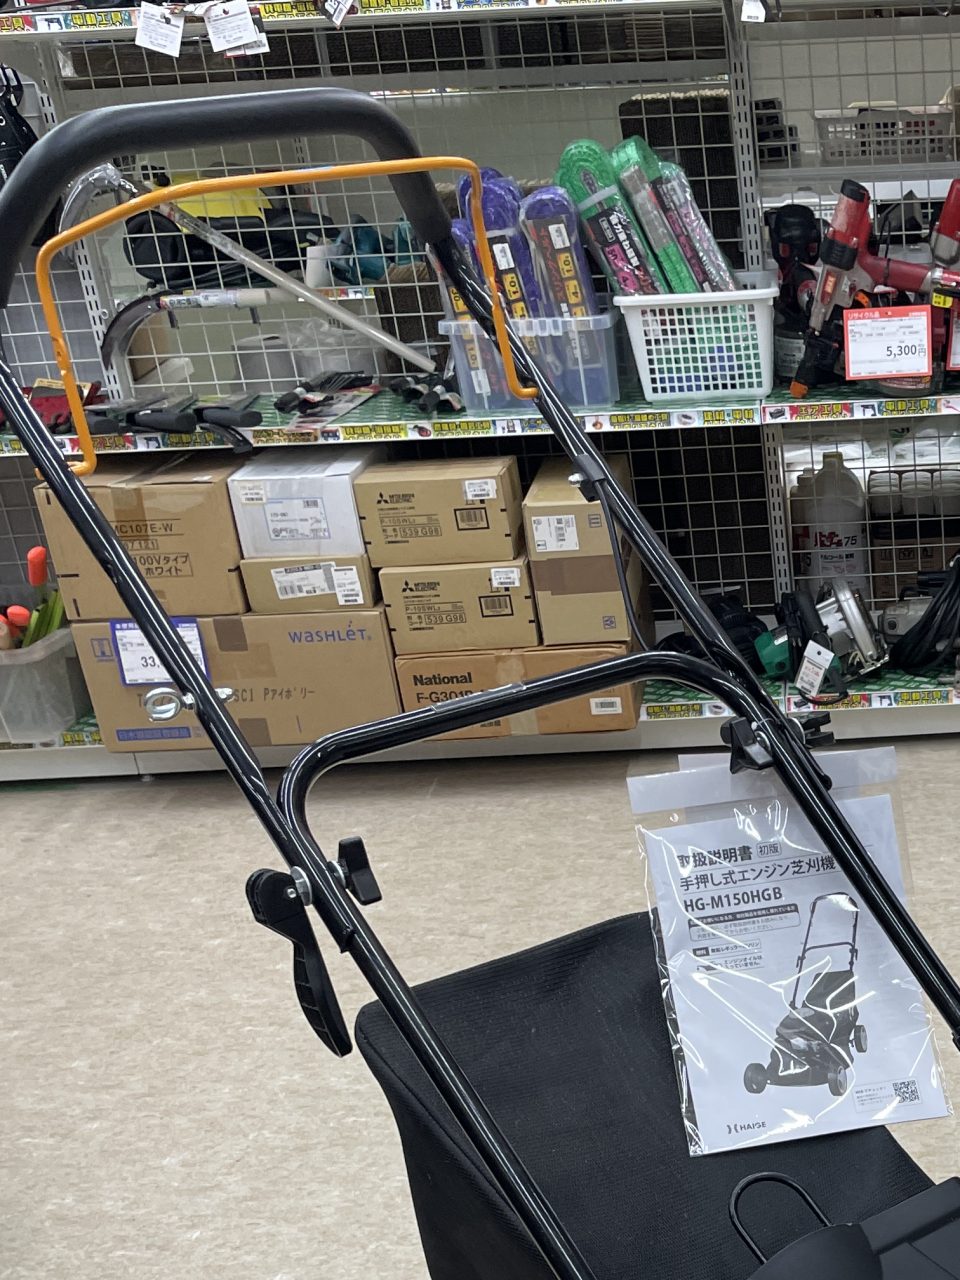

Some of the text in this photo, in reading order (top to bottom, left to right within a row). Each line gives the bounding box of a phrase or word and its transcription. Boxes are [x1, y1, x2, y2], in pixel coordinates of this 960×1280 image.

[145, 565, 182, 577] ホワイト
[413, 671, 473, 687] National
[677, 843, 780, 869] 取扱説明書 初版
[680, 855, 836, 892] 手押し式エンジン芝刈機
[684, 886, 783, 913] HG-M150HGB
[740, 1121, 767, 1131] HAIGE
